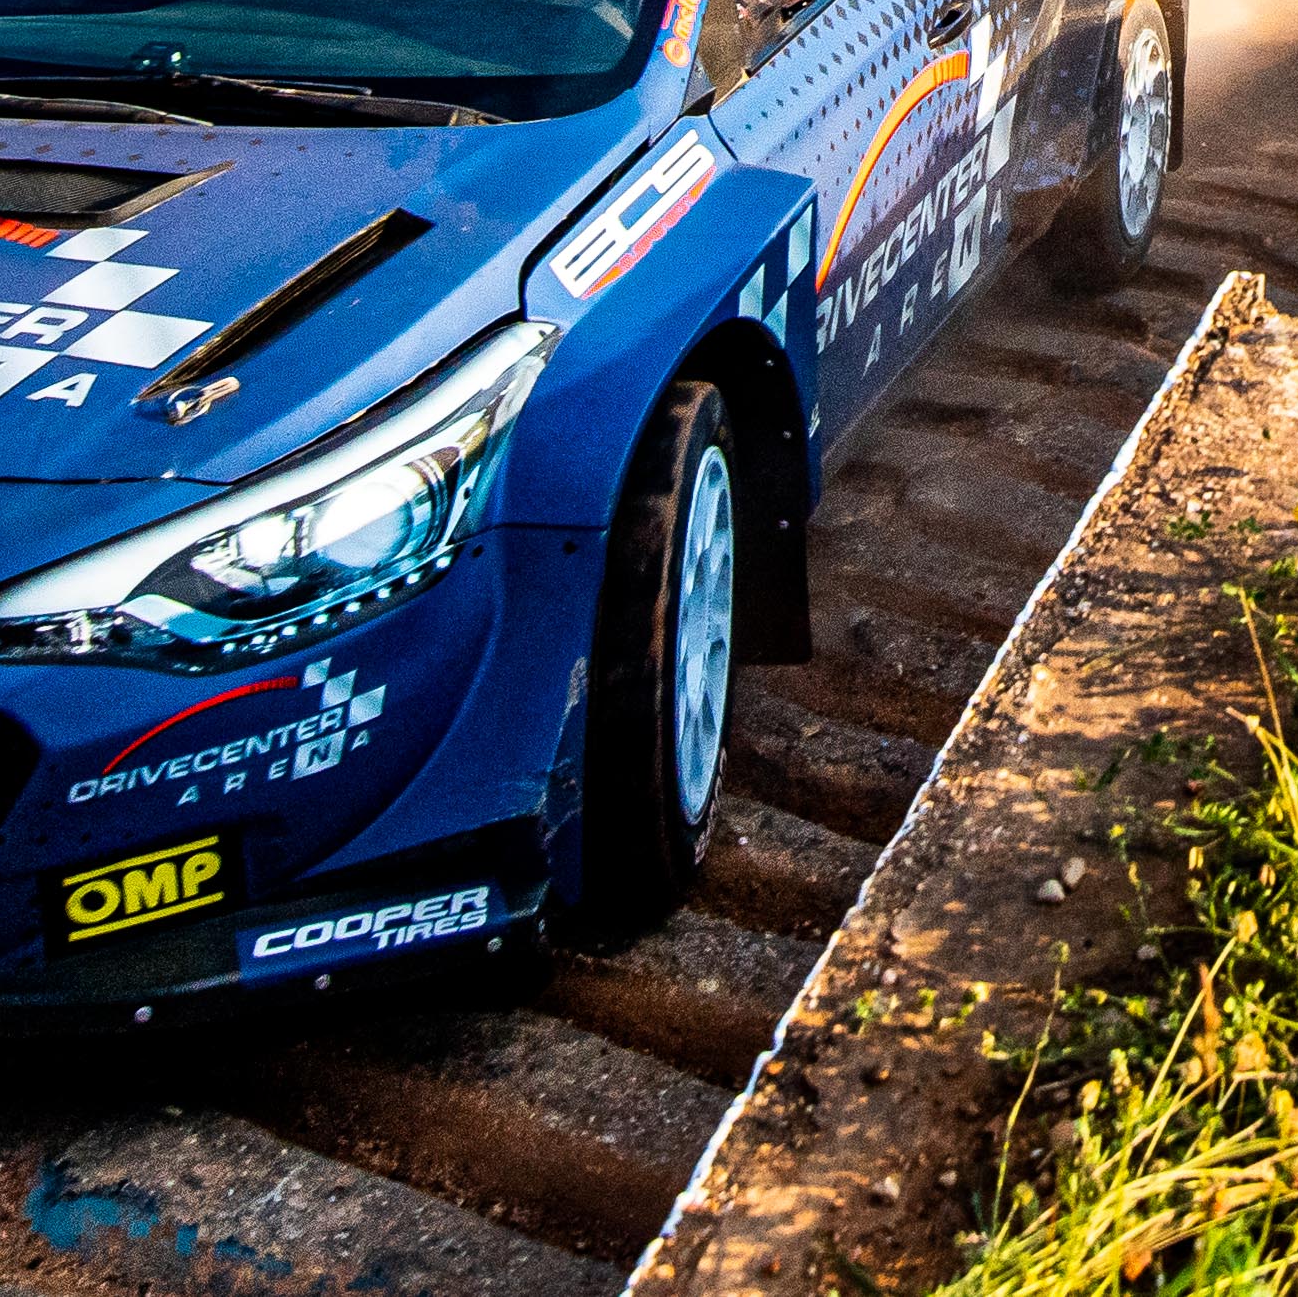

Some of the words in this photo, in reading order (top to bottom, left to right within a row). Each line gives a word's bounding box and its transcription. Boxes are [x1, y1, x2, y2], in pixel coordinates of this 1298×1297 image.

[816, 134, 988, 355] RIVECENTER
[69, 707, 347, 803] DRIVECENTER
[177, 729, 371, 806] ARENA
[64, 851, 222, 927] OMP
[253, 886, 490, 958] COOPER
[374, 908, 488, 951] TIRES
